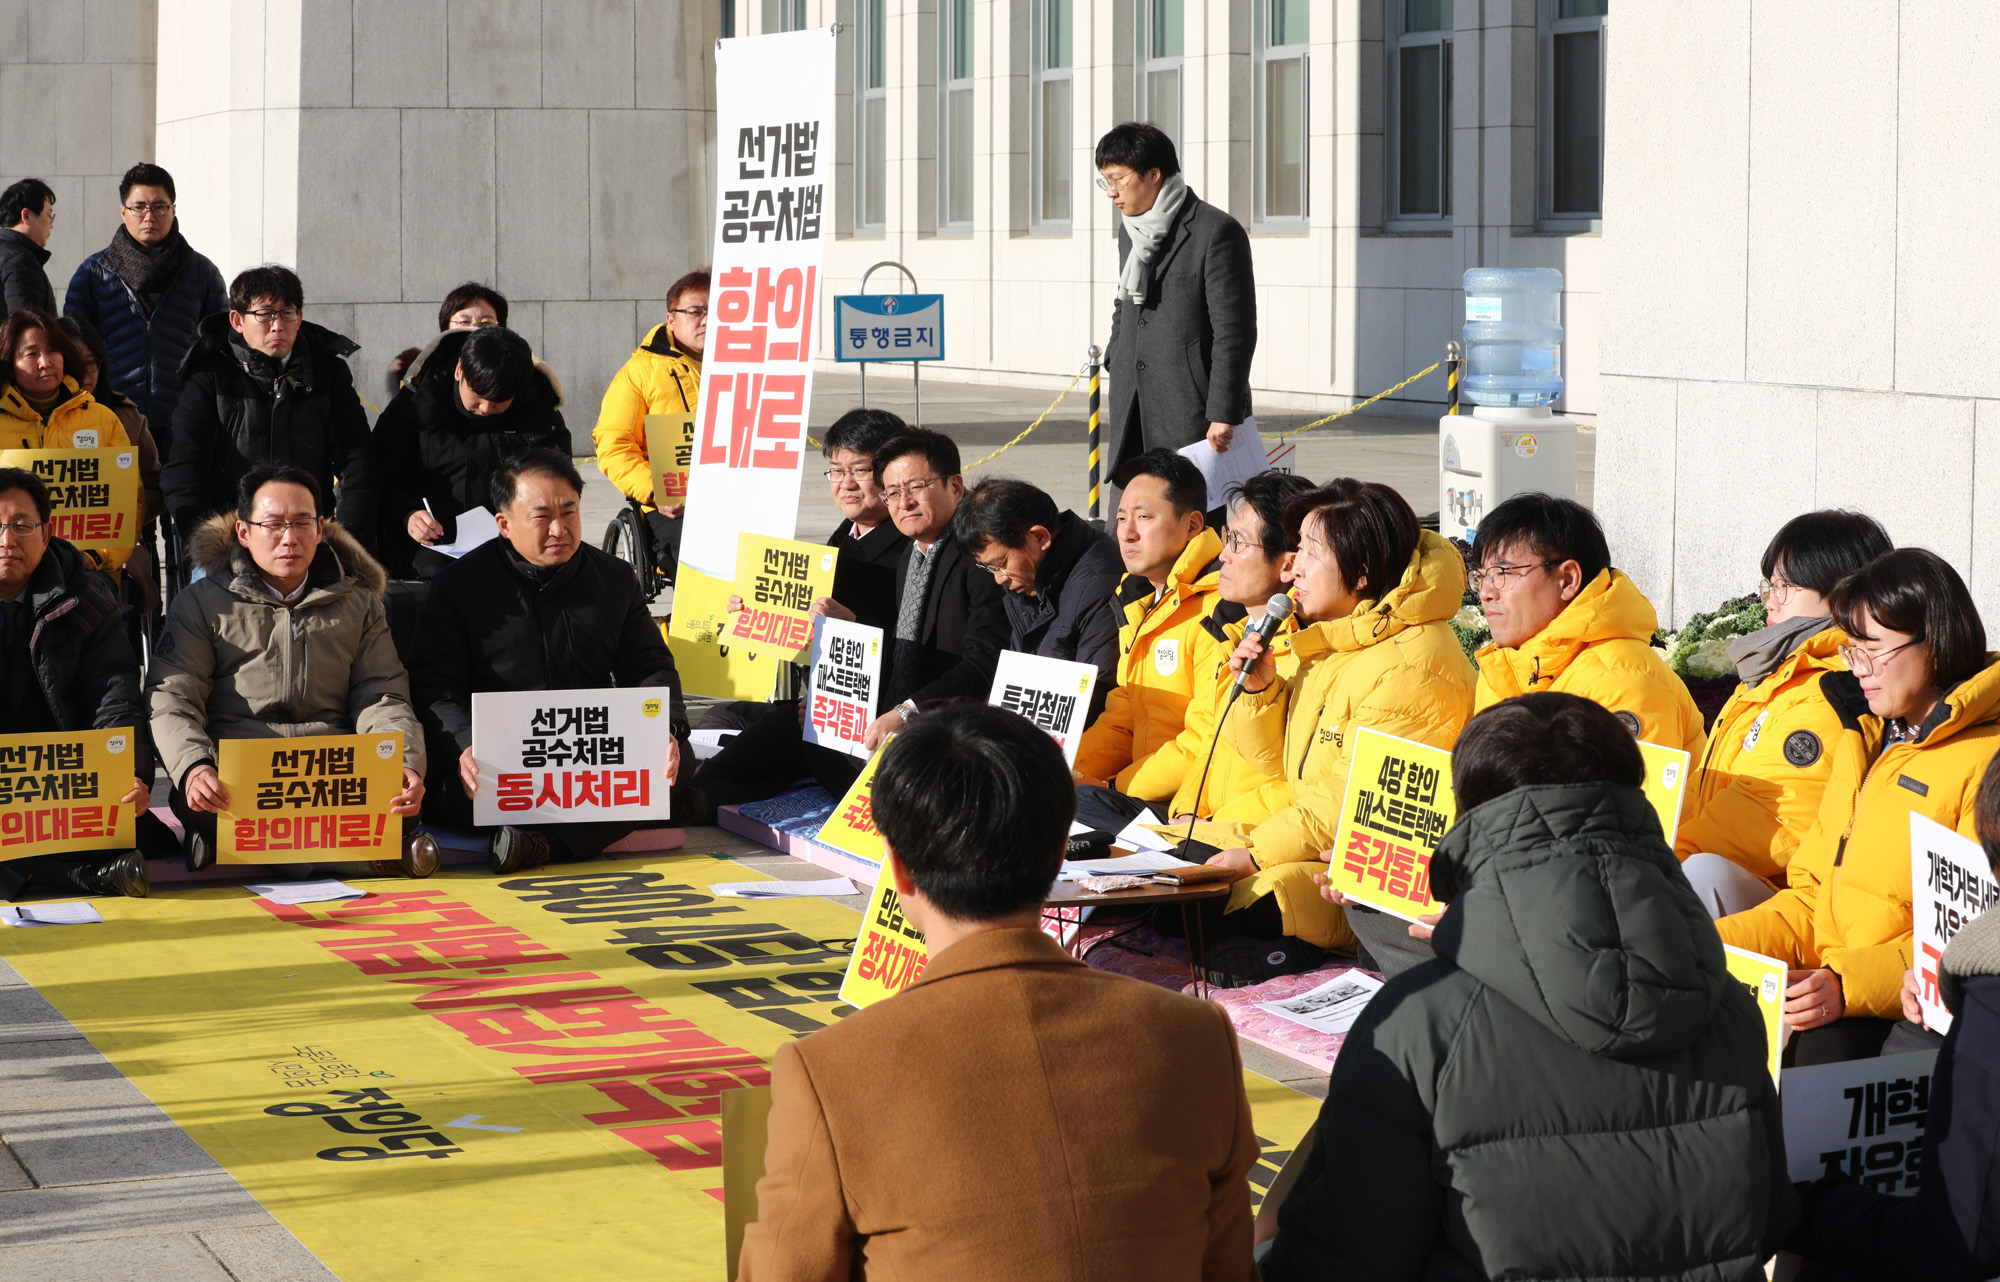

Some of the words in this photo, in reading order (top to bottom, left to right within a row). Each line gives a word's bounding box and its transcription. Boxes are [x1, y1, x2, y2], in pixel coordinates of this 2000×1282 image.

[737, 121, 819, 180] 선거법
[722, 184, 823, 243] 공수처법
[714, 265, 817, 364] 합의
[849, 326, 933, 349] 통행금지
[77, 435, 95, 444] 정의당
[699, 373, 806, 470] 대로
[32, 458, 99, 483] 선거법
[47, 484, 109, 509] 수처법
[50, 513, 124, 540] 대로!
[764, 548, 810, 581] 선거법
[755, 576, 814, 612] 공수처법
[732, 607, 815, 652] 합의대로!
[829, 636, 844, 665] 4당
[845, 639, 865, 670] 합의
[1158, 649, 1174, 661] 정의당
[817, 664, 871, 703] 패스트트랙법
[531, 706, 609, 736] 선거법
[812, 695, 868, 744] 즉각통과
[0, 743, 84, 773] 선거법
[271, 747, 355, 778] 선거법
[522, 737, 624, 768] 공수처법
[257, 777, 367, 810] 공수처법
[497, 769, 650, 811] 동시처리
[1377, 755, 1405, 795] 4당
[1405, 762, 1440, 806] 합의
[0, 805, 119, 846] 의대로!
[234, 813, 387, 851] 합의대로!
[1353, 789, 1448, 850] 패스트트랙법
[1343, 830, 1431, 907] 즉각통과
[263, 1087, 466, 1162] 정의당
